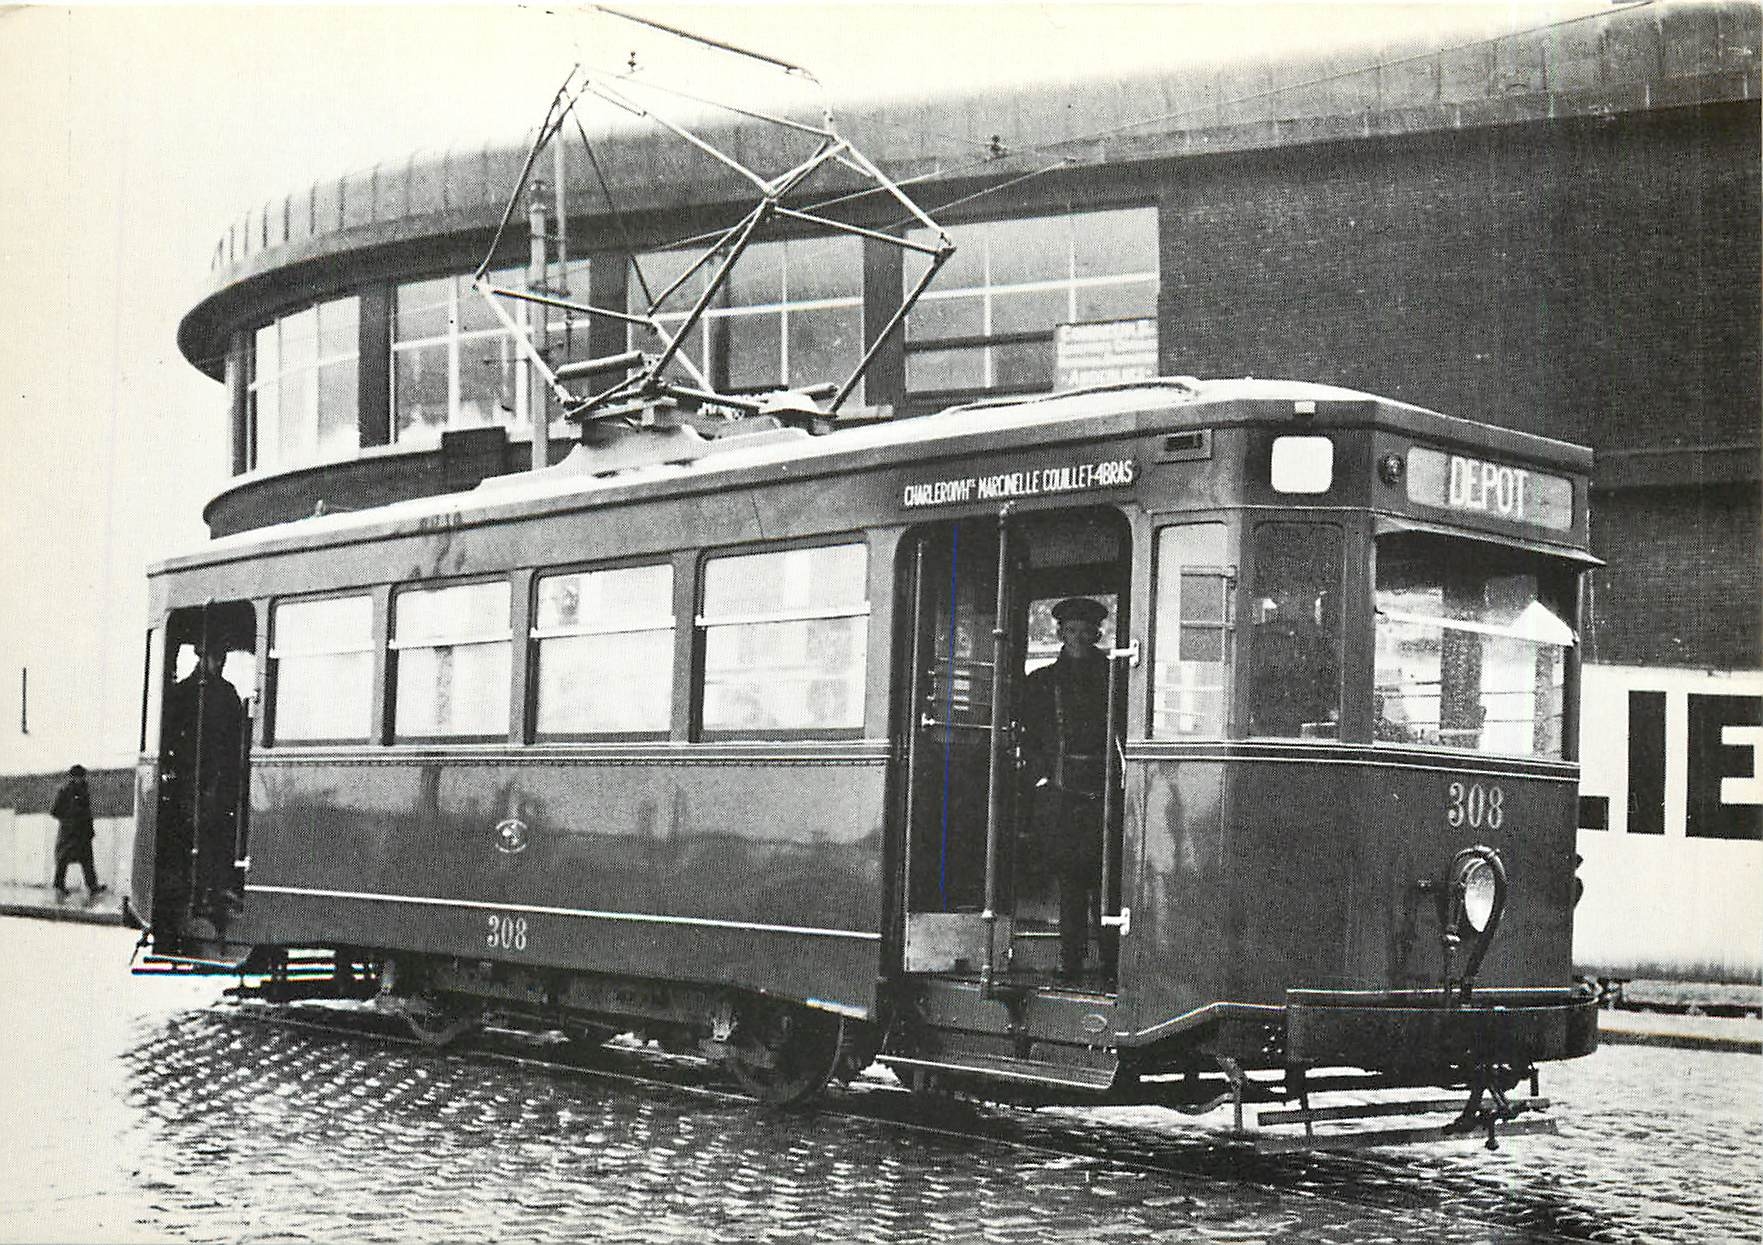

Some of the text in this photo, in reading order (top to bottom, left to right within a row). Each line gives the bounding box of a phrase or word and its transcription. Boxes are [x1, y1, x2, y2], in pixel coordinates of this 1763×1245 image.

[978, 470, 1040, 499] MARCINELLE
[1450, 455, 1529, 519] DEPOT
[1578, 689, 1763, 841] IE
[1448, 782, 1503, 829] 308
[487, 915, 527, 950] 308
